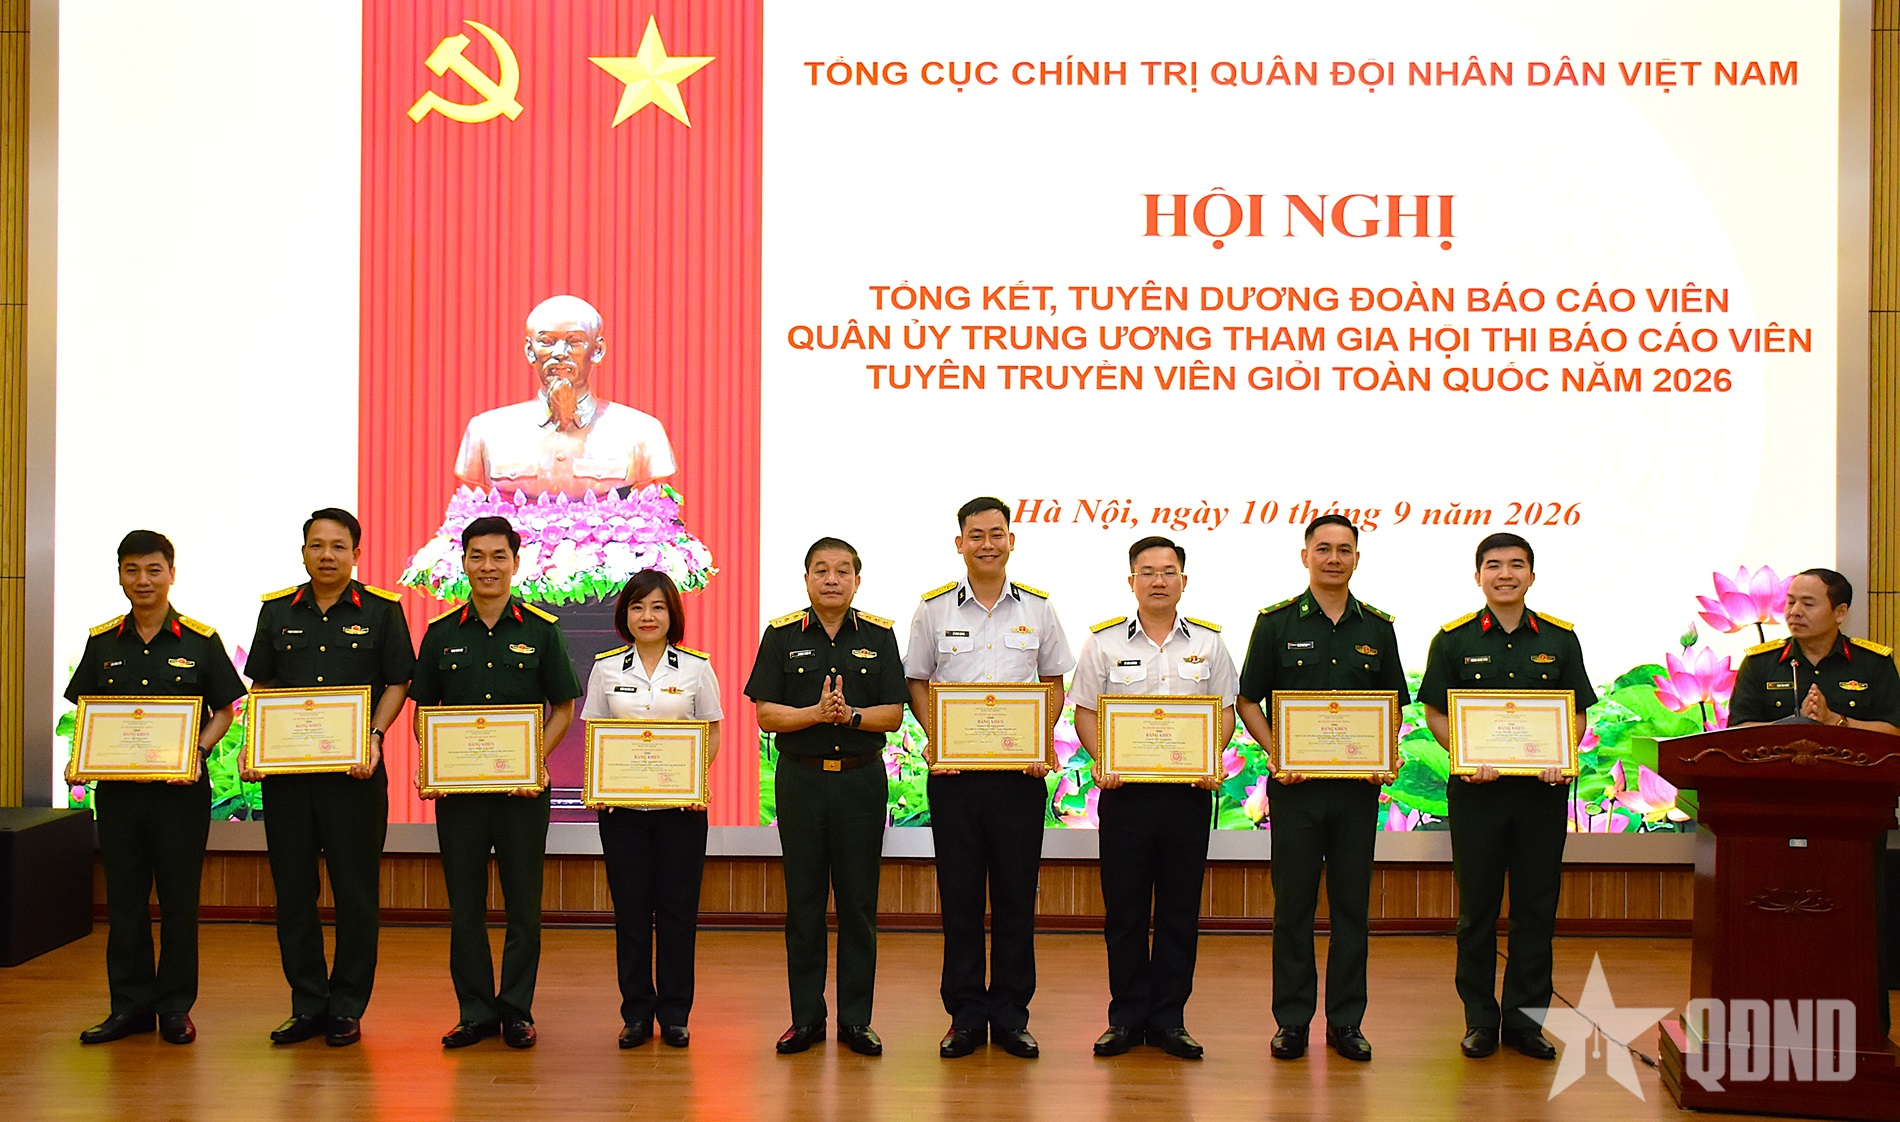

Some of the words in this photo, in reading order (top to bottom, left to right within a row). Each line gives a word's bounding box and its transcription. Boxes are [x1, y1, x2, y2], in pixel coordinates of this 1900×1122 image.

[921, 62, 998, 92] CỤC
[1012, 55, 1126, 85] CHÍNH
[1141, 62, 1197, 93] TRỊ
[1211, 55, 1317, 87] QUÂN
[1330, 58, 1394, 93] ĐỘI
[1409, 56, 1512, 86] NHÂN
[1528, 55, 1604, 86] DÂN
[1618, 58, 1702, 93] VIỆT
[1714, 61, 1797, 86] NAM
[1142, 186, 1266, 249] HỘI
[1284, 193, 1456, 250] NGHỊ
[869, 280, 970, 310] TỔNG
[983, 280, 1056, 316] KẾT,
[1068, 280, 1187, 310] TUYÊN
[1201, 287, 1338, 311] DƯƠNG
[1349, 281, 1454, 312] ĐOÀN
[1468, 282, 1545, 312] BÁO
[1556, 282, 1635, 312] CÁO
[1646, 282, 1728, 312] VIÊN
[788, 319, 890, 350] QUÂN
[904, 319, 951, 350] ỦY
[961, 326, 1086, 350] TRUNG
[1100, 326, 1211, 350] ƯƠNG
[1223, 327, 1324, 351] THAM
[1337, 327, 1398, 351] GIA
[1410, 325, 1469, 359] HỘI
[1481, 328, 1536, 352] THI
[1549, 322, 1627, 352] BÁO
[1639, 322, 1718, 352] CÁO
[1728, 322, 1811, 352] VIÊN
[866, 359, 985, 389] TUYÊN
[997, 360, 1142, 390] TRUYỀN
[1154, 360, 1235, 390] VIÊN
[1248, 360, 1319, 390] GIỎI
[1332, 360, 1430, 391] TOÀN
[1443, 362, 1548, 393] QUỐC
[1562, 361, 1641, 392] NĂM
[1653, 368, 1732, 392] 2026
[1014, 499, 1061, 524] Hà
[1074, 499, 1138, 530] Nội,
[1151, 501, 1228, 531] ngày
[1241, 500, 1279, 524] 10
[1288, 500, 1382, 532] tháng
[1394, 501, 1412, 526] 9
[1420, 501, 1491, 526] năm
[1505, 502, 1582, 527] 2026
